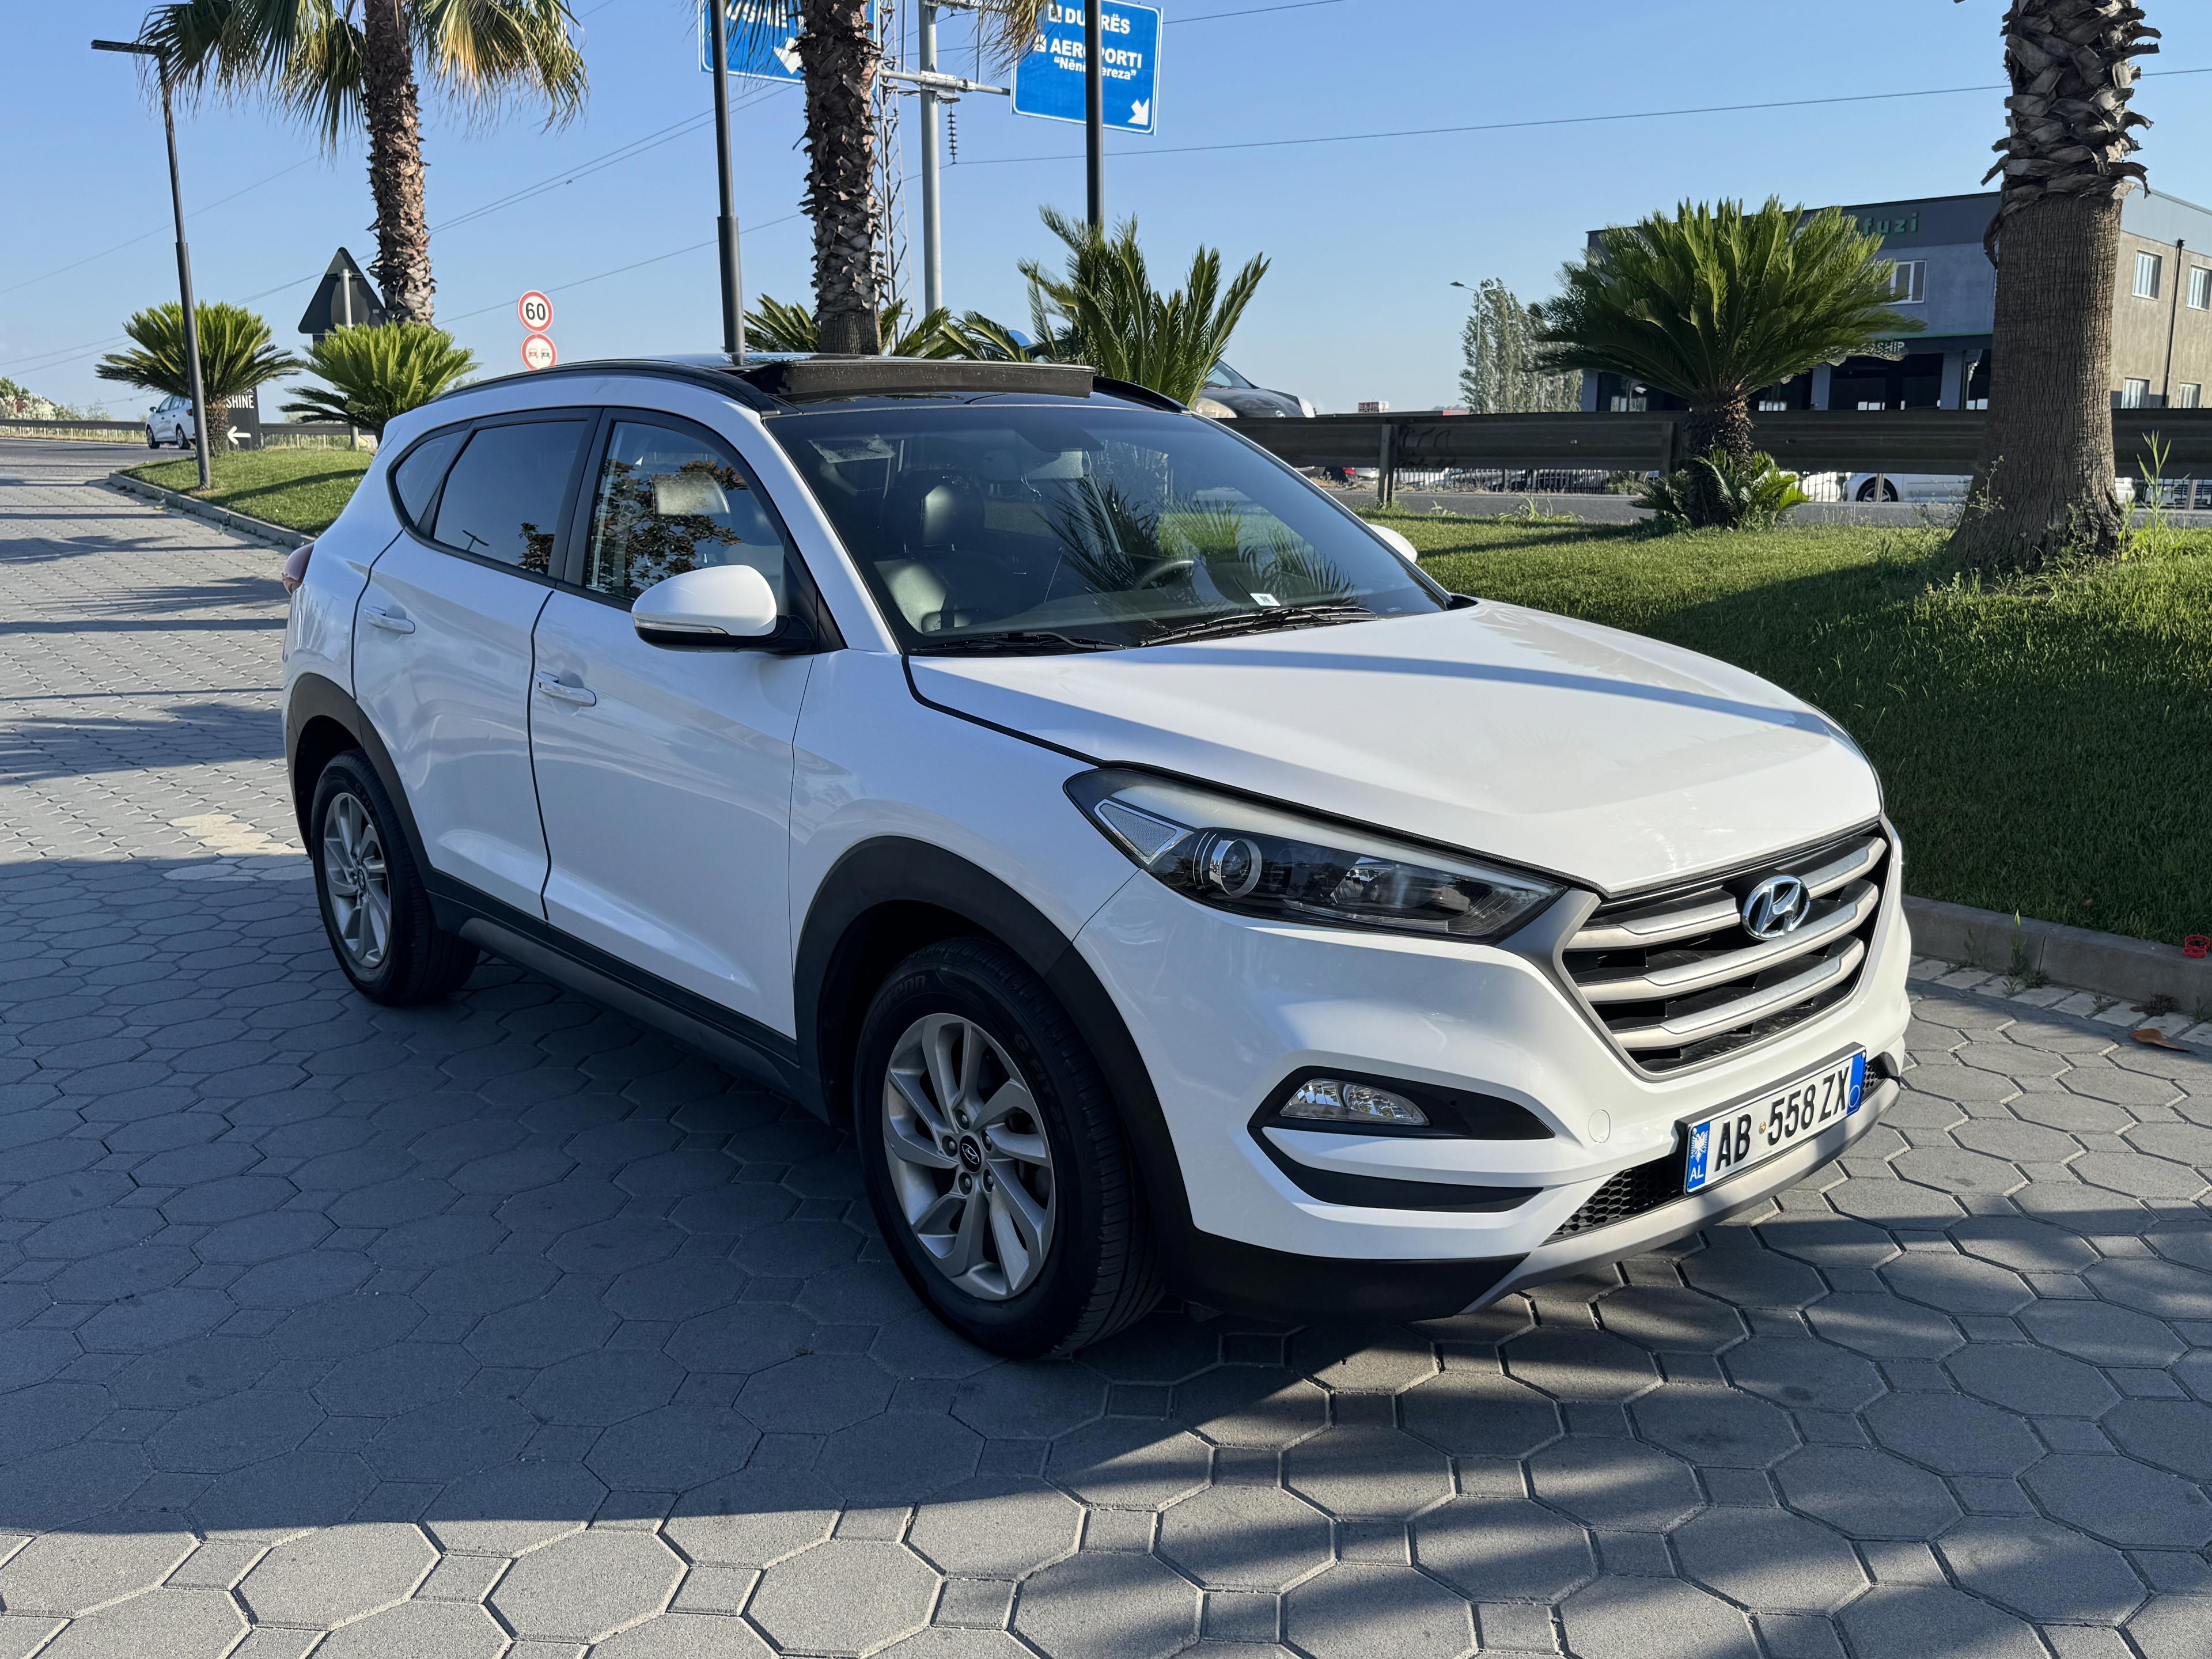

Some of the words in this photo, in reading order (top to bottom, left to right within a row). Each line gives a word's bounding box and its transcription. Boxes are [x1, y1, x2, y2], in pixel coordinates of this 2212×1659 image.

[1065, 7, 1131, 35] DURËS
[1050, 38, 1142, 69] AERORTI
[525, 302, 546, 321] 60
[1689, 1165, 1704, 1182] AL
[1714, 1113, 1752, 1172] AB
[1767, 1084, 1816, 1146] 558
[1818, 1065, 1850, 1123] ZX
